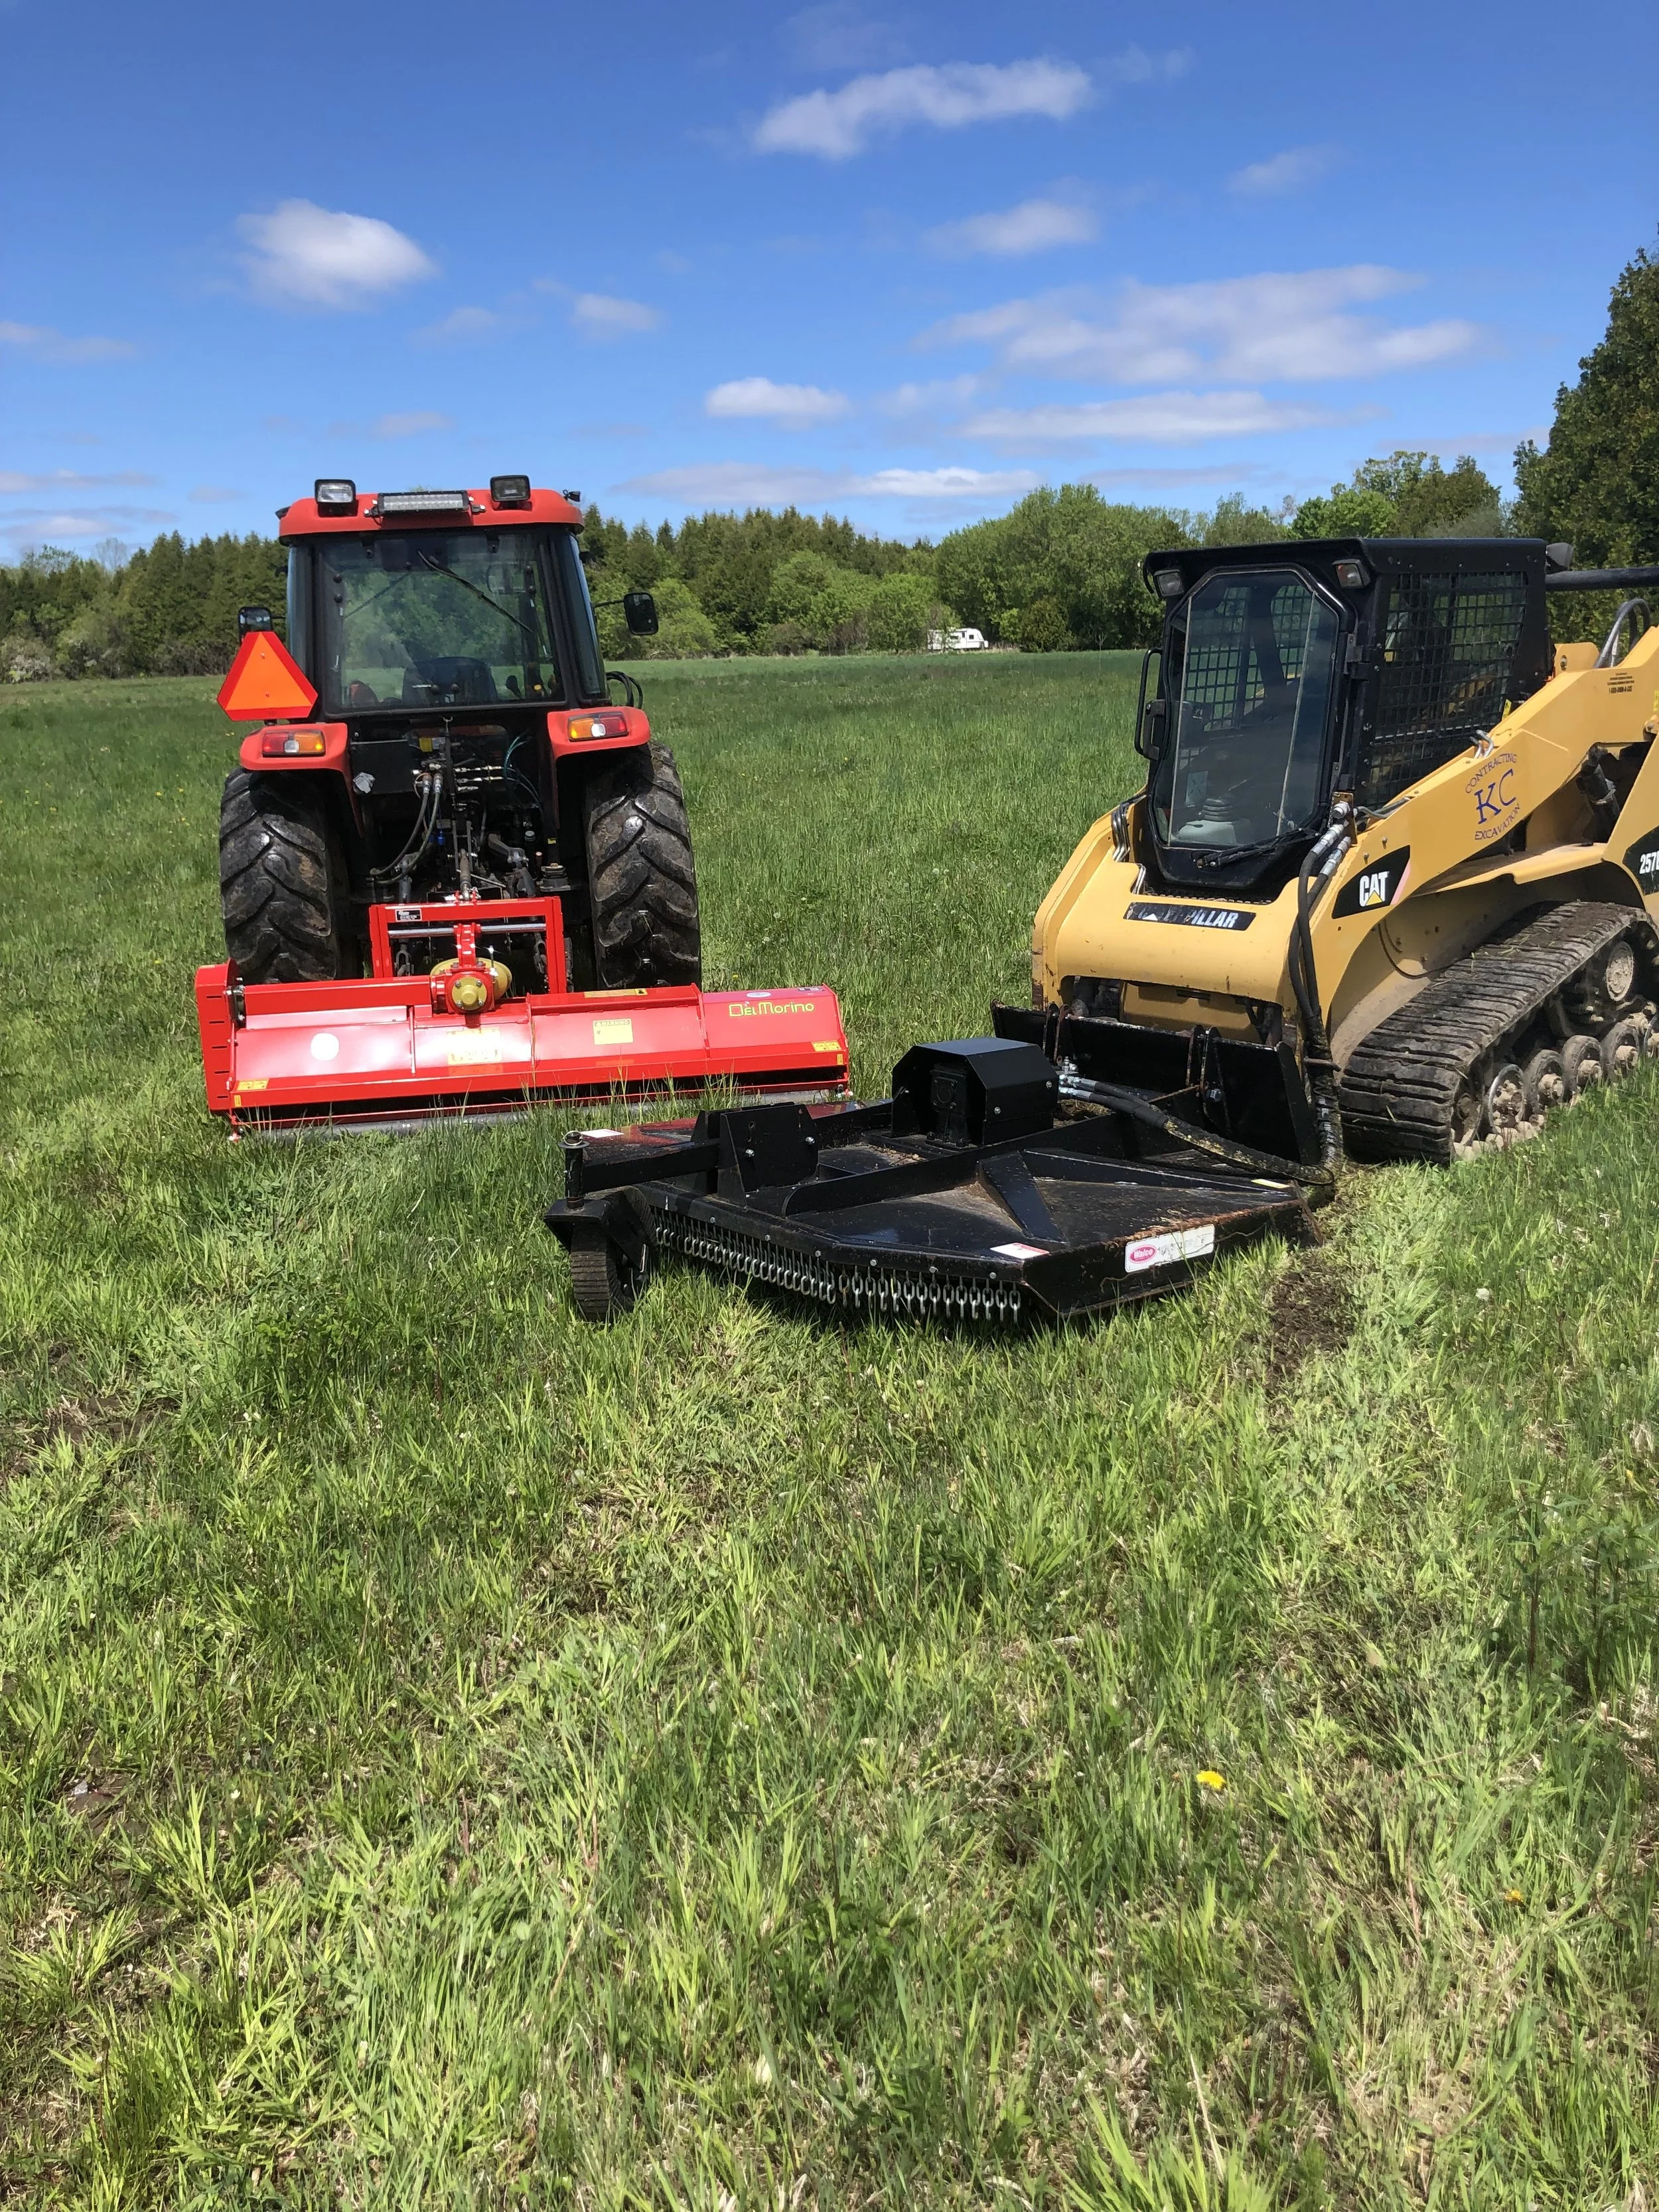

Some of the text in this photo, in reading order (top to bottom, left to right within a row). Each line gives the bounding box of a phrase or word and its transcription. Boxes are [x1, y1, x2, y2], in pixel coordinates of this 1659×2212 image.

[1465, 753, 1517, 794] CONTRACTING
[1474, 768, 1516, 824] KC
[1474, 802, 1520, 840] EXCAVATION
[1359, 871, 1390, 907] CAT
[1137, 906, 1239, 928] CPILLAR
[1133, 1248, 1154, 1259] Walco
